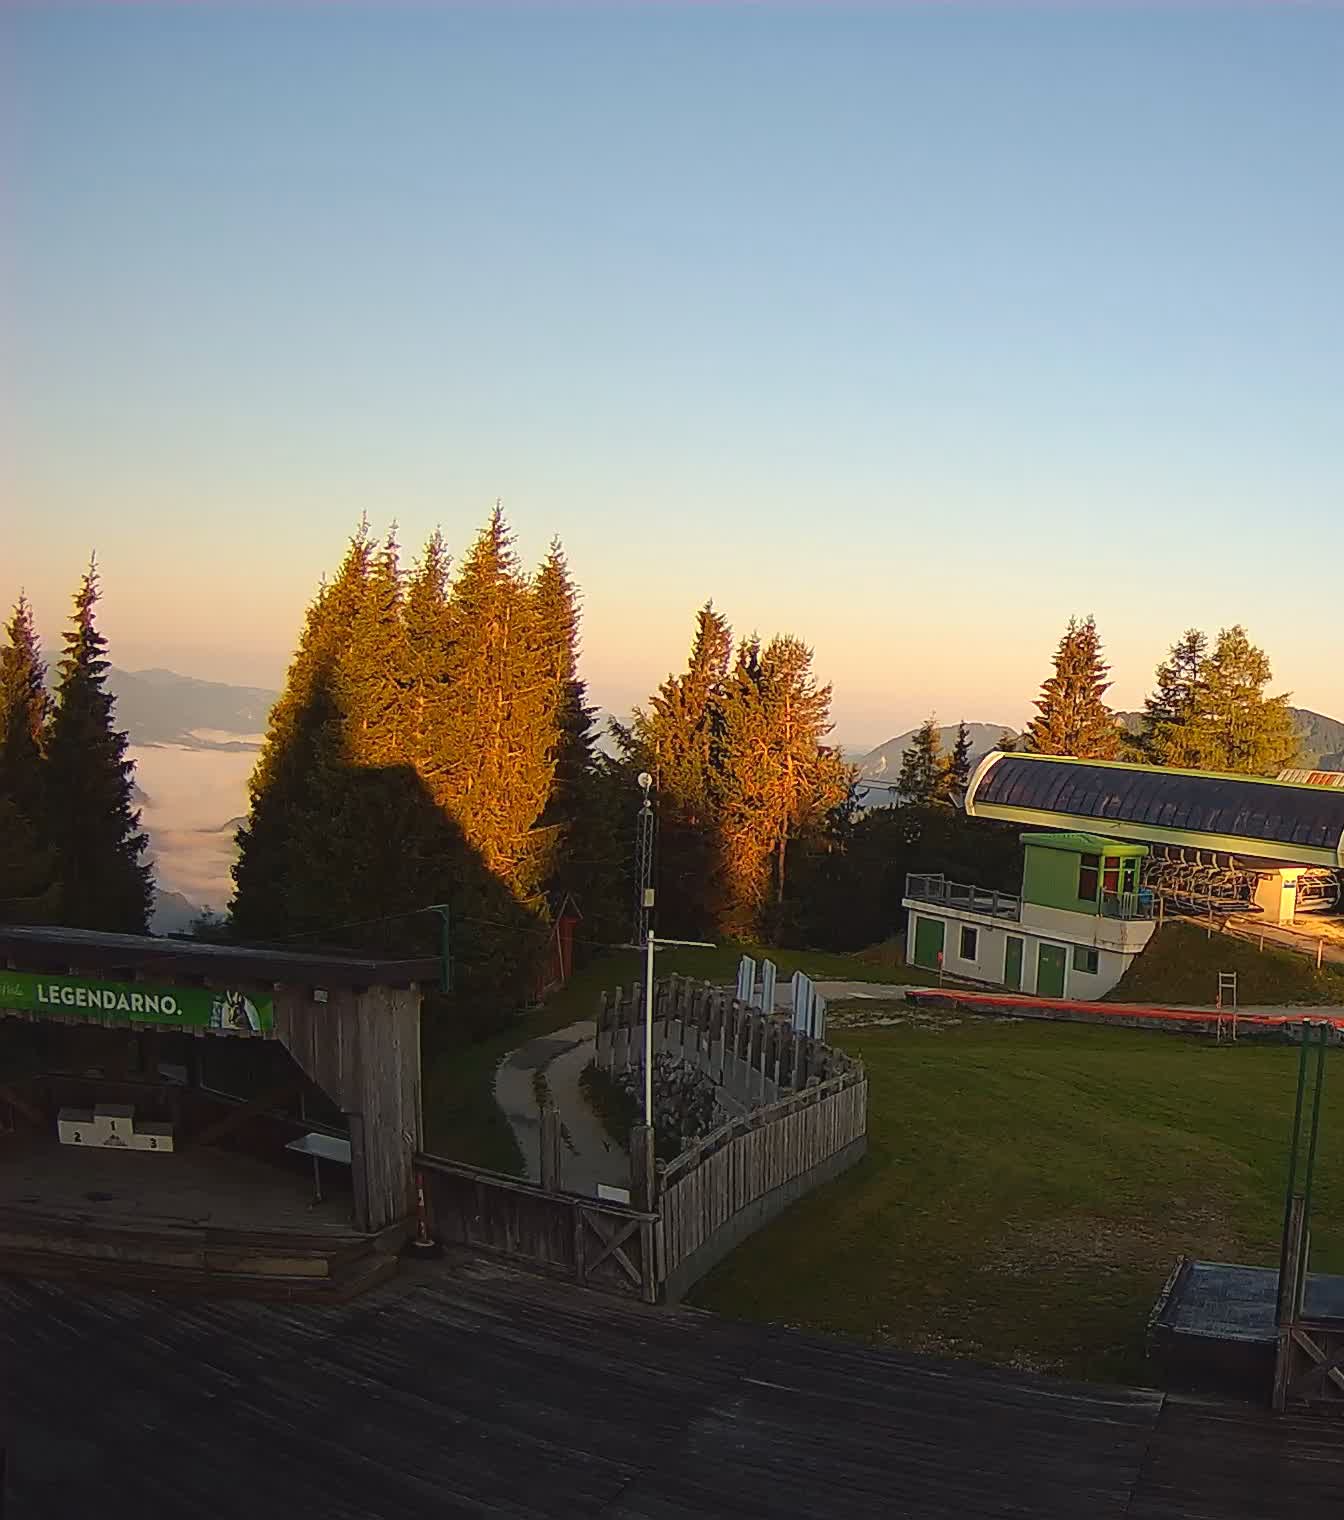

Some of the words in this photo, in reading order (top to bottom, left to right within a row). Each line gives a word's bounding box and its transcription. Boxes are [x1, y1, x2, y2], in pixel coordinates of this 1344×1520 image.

[37, 984, 183, 1016] LEGENDARNO.
[110, 1121, 116, 1132] 1
[74, 1132, 82, 1143] 2
[150, 1138, 157, 1149] 3
